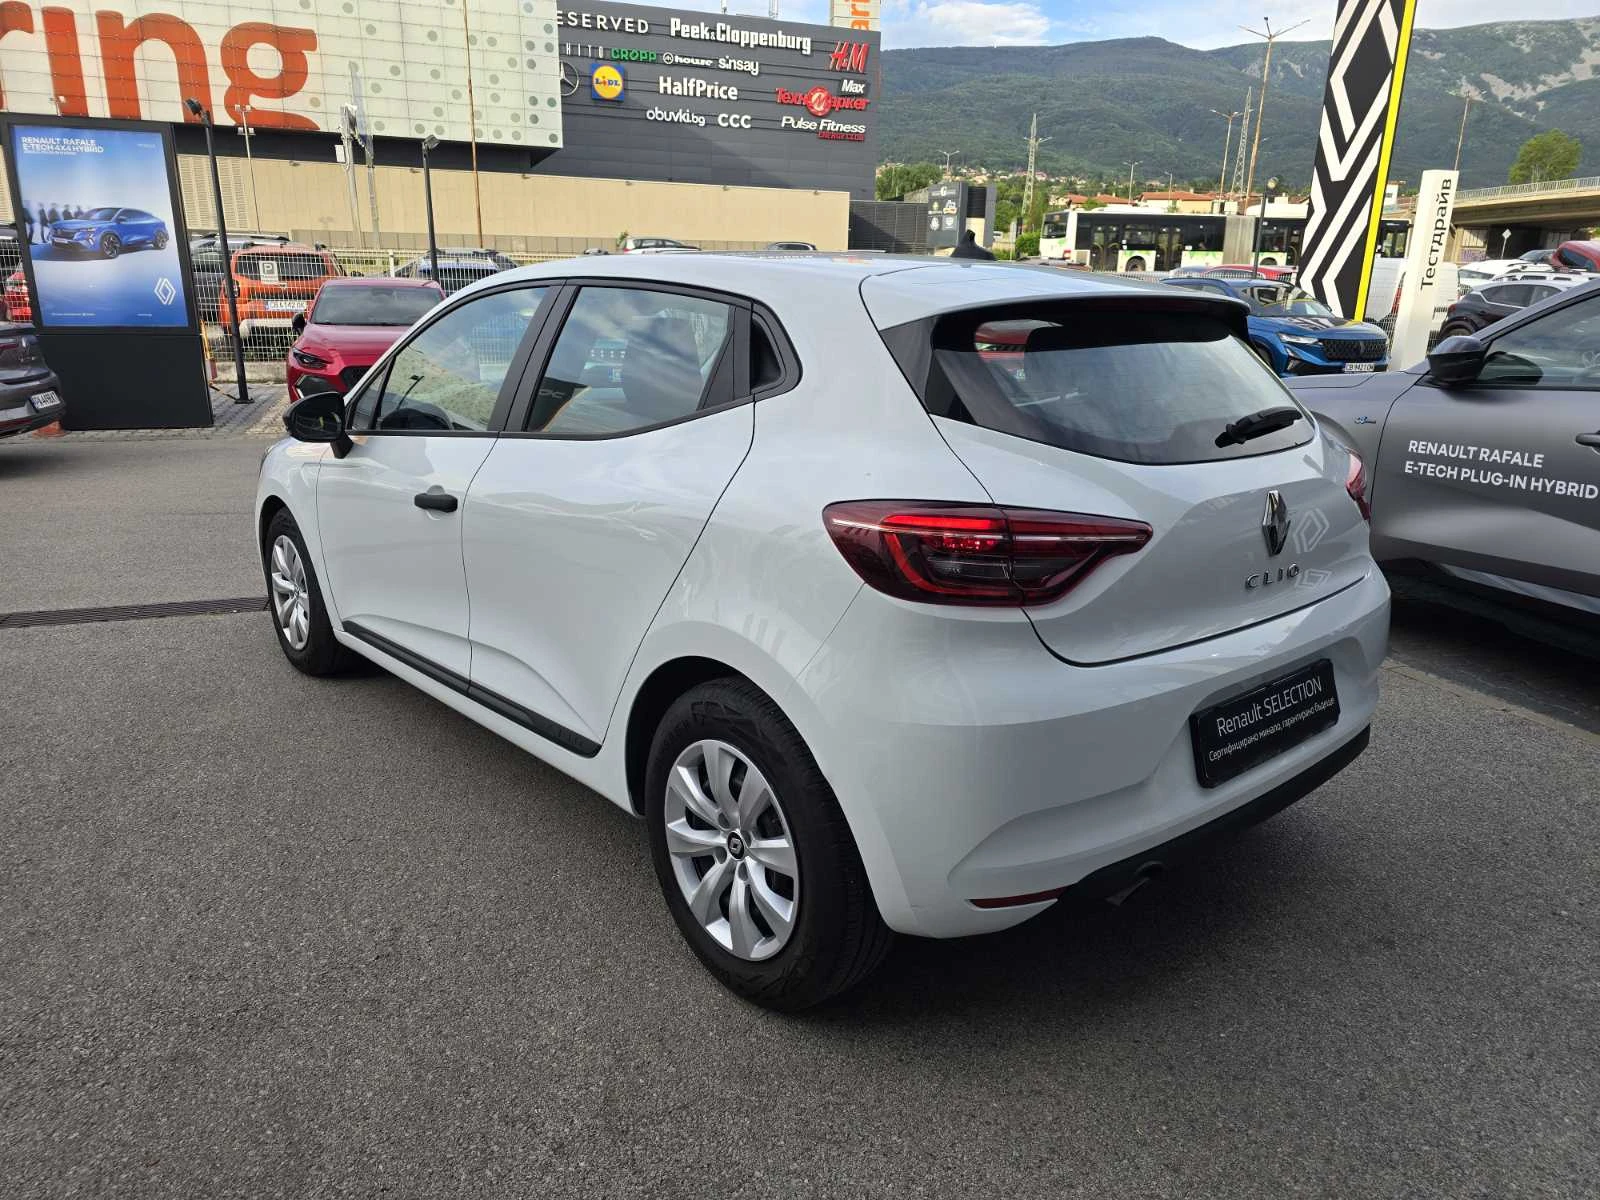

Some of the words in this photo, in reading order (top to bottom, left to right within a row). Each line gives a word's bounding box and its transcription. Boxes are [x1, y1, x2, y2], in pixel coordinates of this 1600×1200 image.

[611, 48, 657, 62] CROPP
[829, 41, 870, 74] H&M
[659, 76, 738, 100] HalfPrice
[646, 107, 706, 127] obuvki.bg
[718, 113, 752, 129] CCC
[781, 116, 817, 130] Pulse
[819, 119, 866, 134] Fitness
[1421, 178, 1452, 290] Тестдрайв
[1408, 440, 1478, 460] RENAULT
[1479, 447, 1544, 469] RAFALE
[1404, 461, 1459, 480] E-TECH
[1460, 468, 1528, 490] PLUG-IN
[1530, 474, 1599, 500] HYBRID
[1245, 563, 1300, 590] CLIO
[1216, 703, 1263, 737] Renault
[1264, 675, 1322, 717] SELECTION
